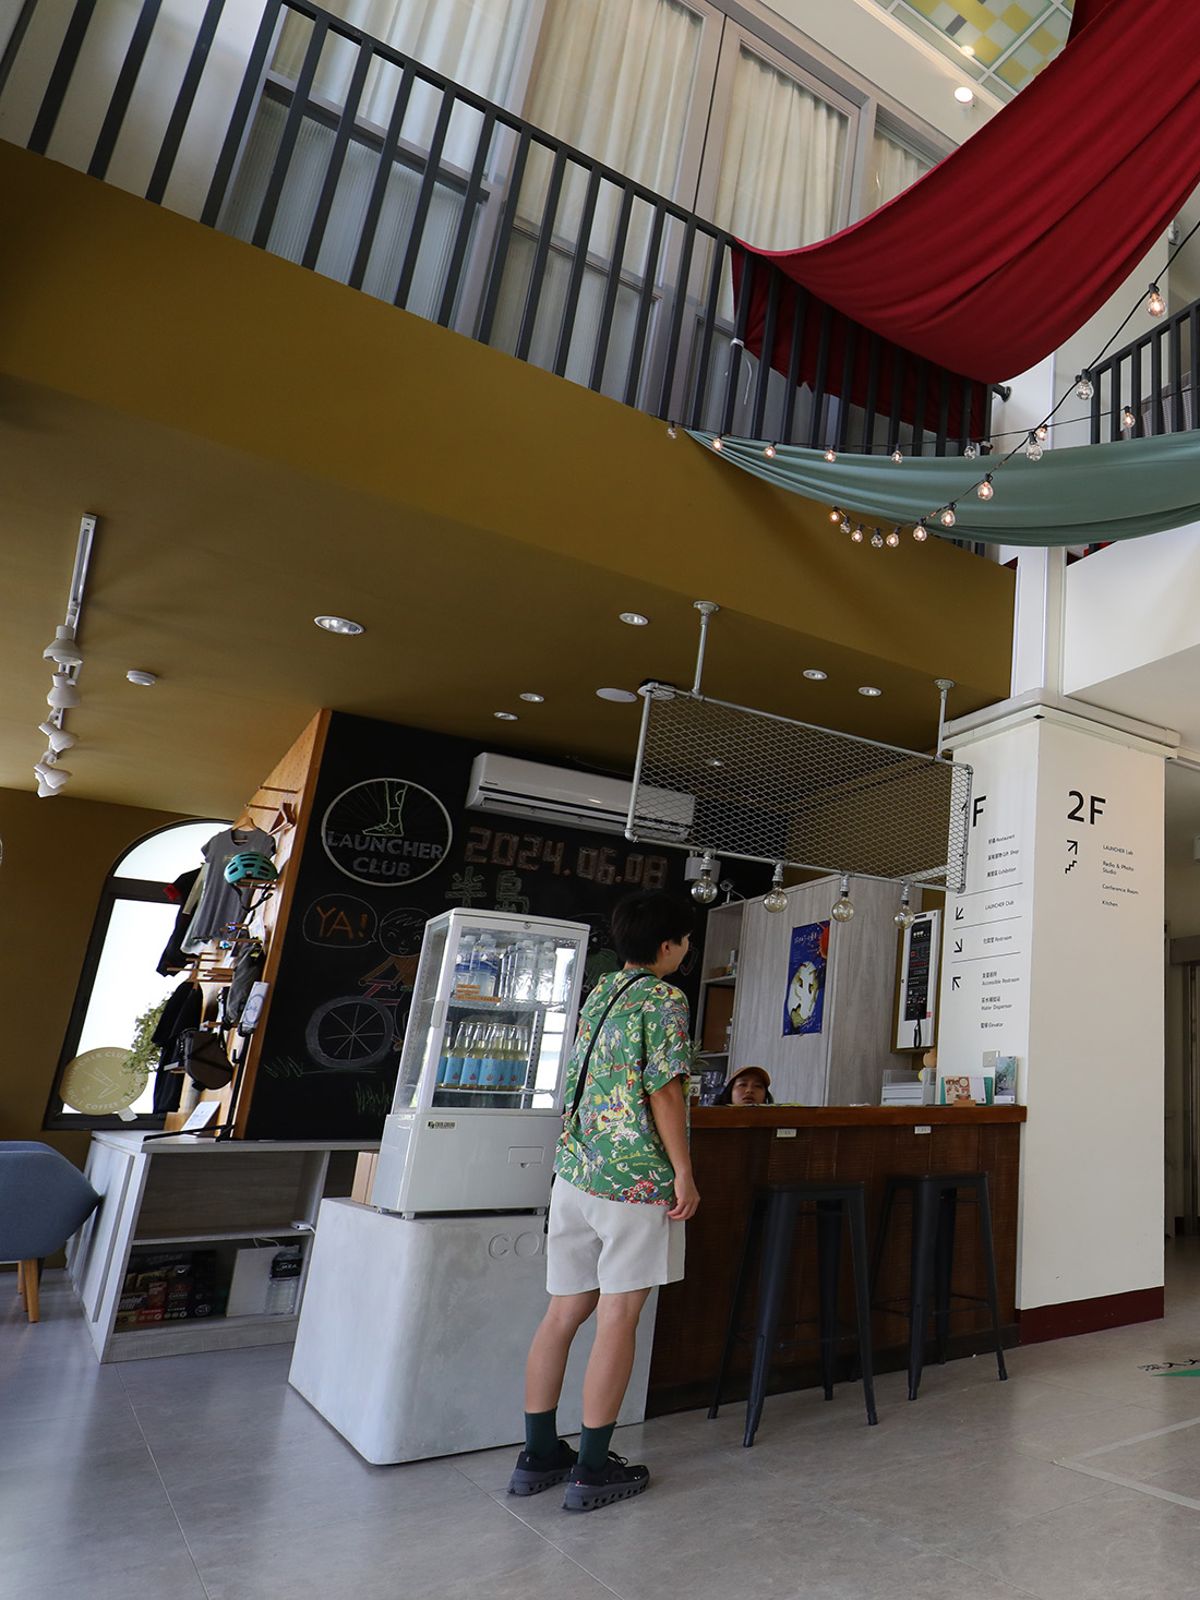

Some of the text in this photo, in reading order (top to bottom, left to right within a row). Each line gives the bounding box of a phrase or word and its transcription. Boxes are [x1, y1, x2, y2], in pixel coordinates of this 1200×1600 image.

[1067, 790, 1106, 825] 2F
[326, 830, 443, 859] LAUNCHER
[465, 825, 670, 890] 2024.06.08
[352, 856, 411, 878] CLUB
[315, 903, 369, 939] YA!
[488, 1231, 546, 1260] CO
